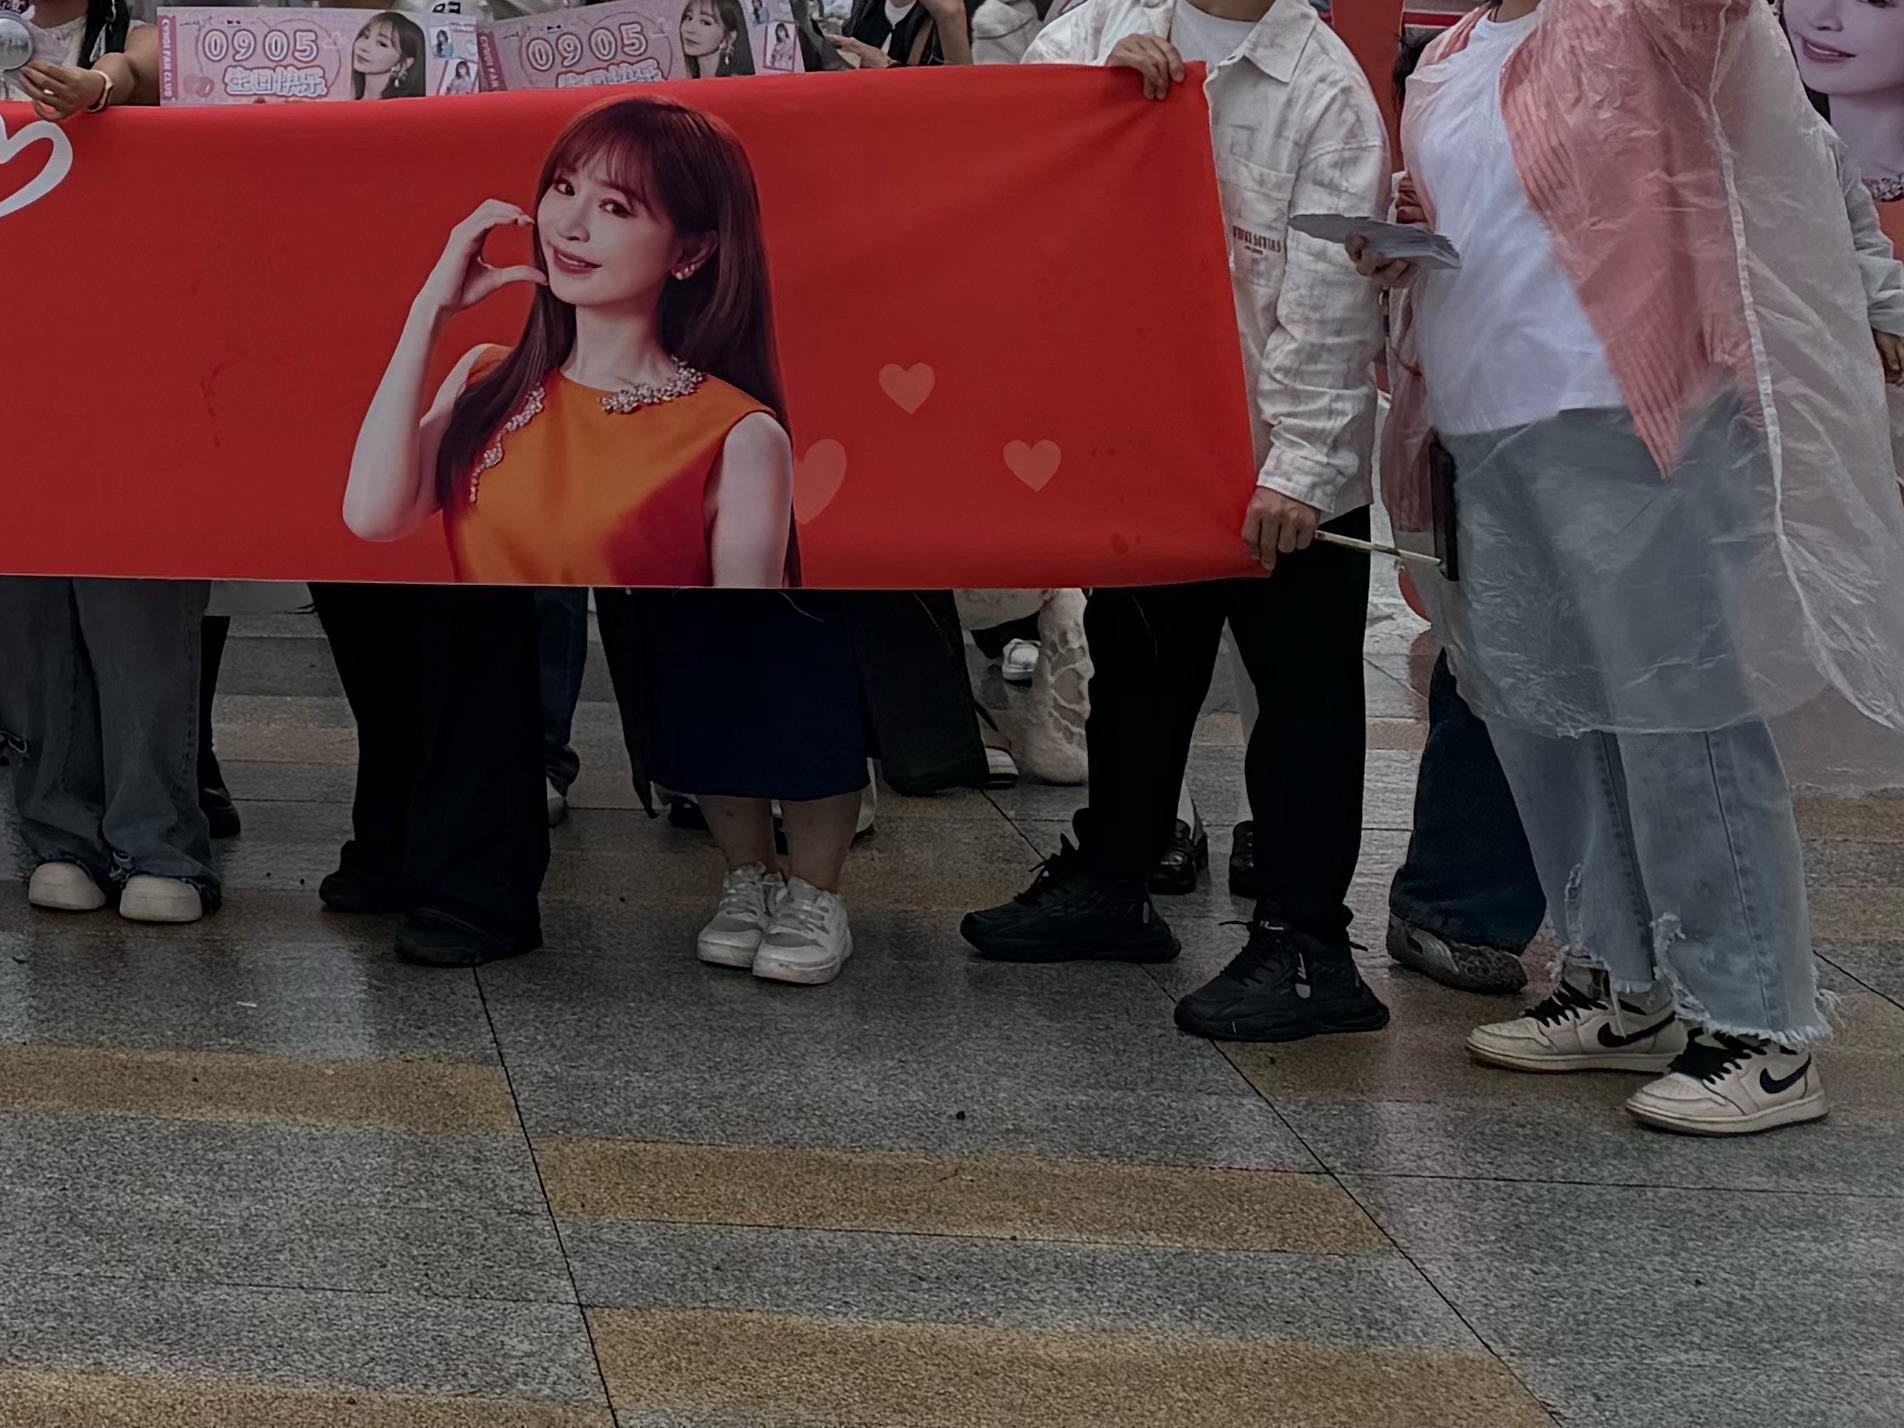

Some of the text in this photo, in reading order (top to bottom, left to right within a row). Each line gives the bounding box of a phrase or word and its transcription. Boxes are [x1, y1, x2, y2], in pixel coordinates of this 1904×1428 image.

[162, 49, 171, 69] FAN
[202, 28, 319, 63] 0905
[526, 20, 649, 72] 0905
[162, 71, 173, 96] CLUB
[223, 64, 329, 99] 生日快乐
